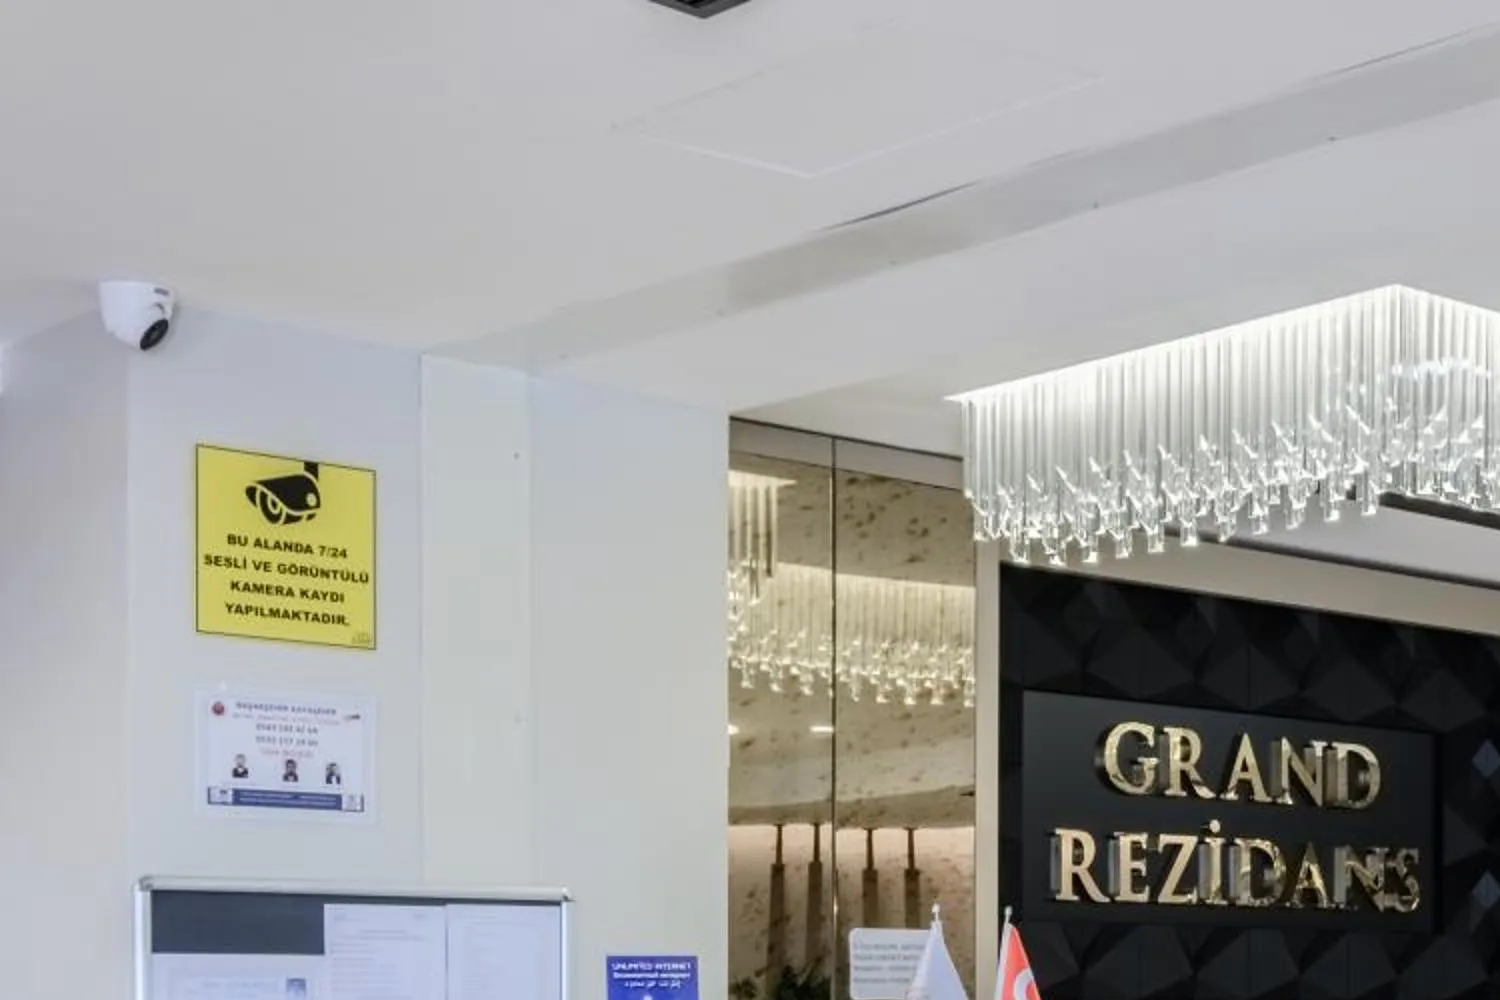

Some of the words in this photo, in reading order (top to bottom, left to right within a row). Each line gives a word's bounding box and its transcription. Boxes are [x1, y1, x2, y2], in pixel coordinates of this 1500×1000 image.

[227, 533, 248, 547] BU
[253, 537, 315, 555] ALANDA
[319, 546, 348, 559] 7/24
[204, 554, 247, 570] SESLİ
[252, 560, 273, 573] VE
[277, 562, 369, 584] GÖRÜNTÜLÜ
[230, 580, 295, 599] KAMERA
[300, 588, 345, 603] KAYDI
[1096, 721, 1381, 810] GRAND
[1050, 819, 1420, 912] REZİDANS
